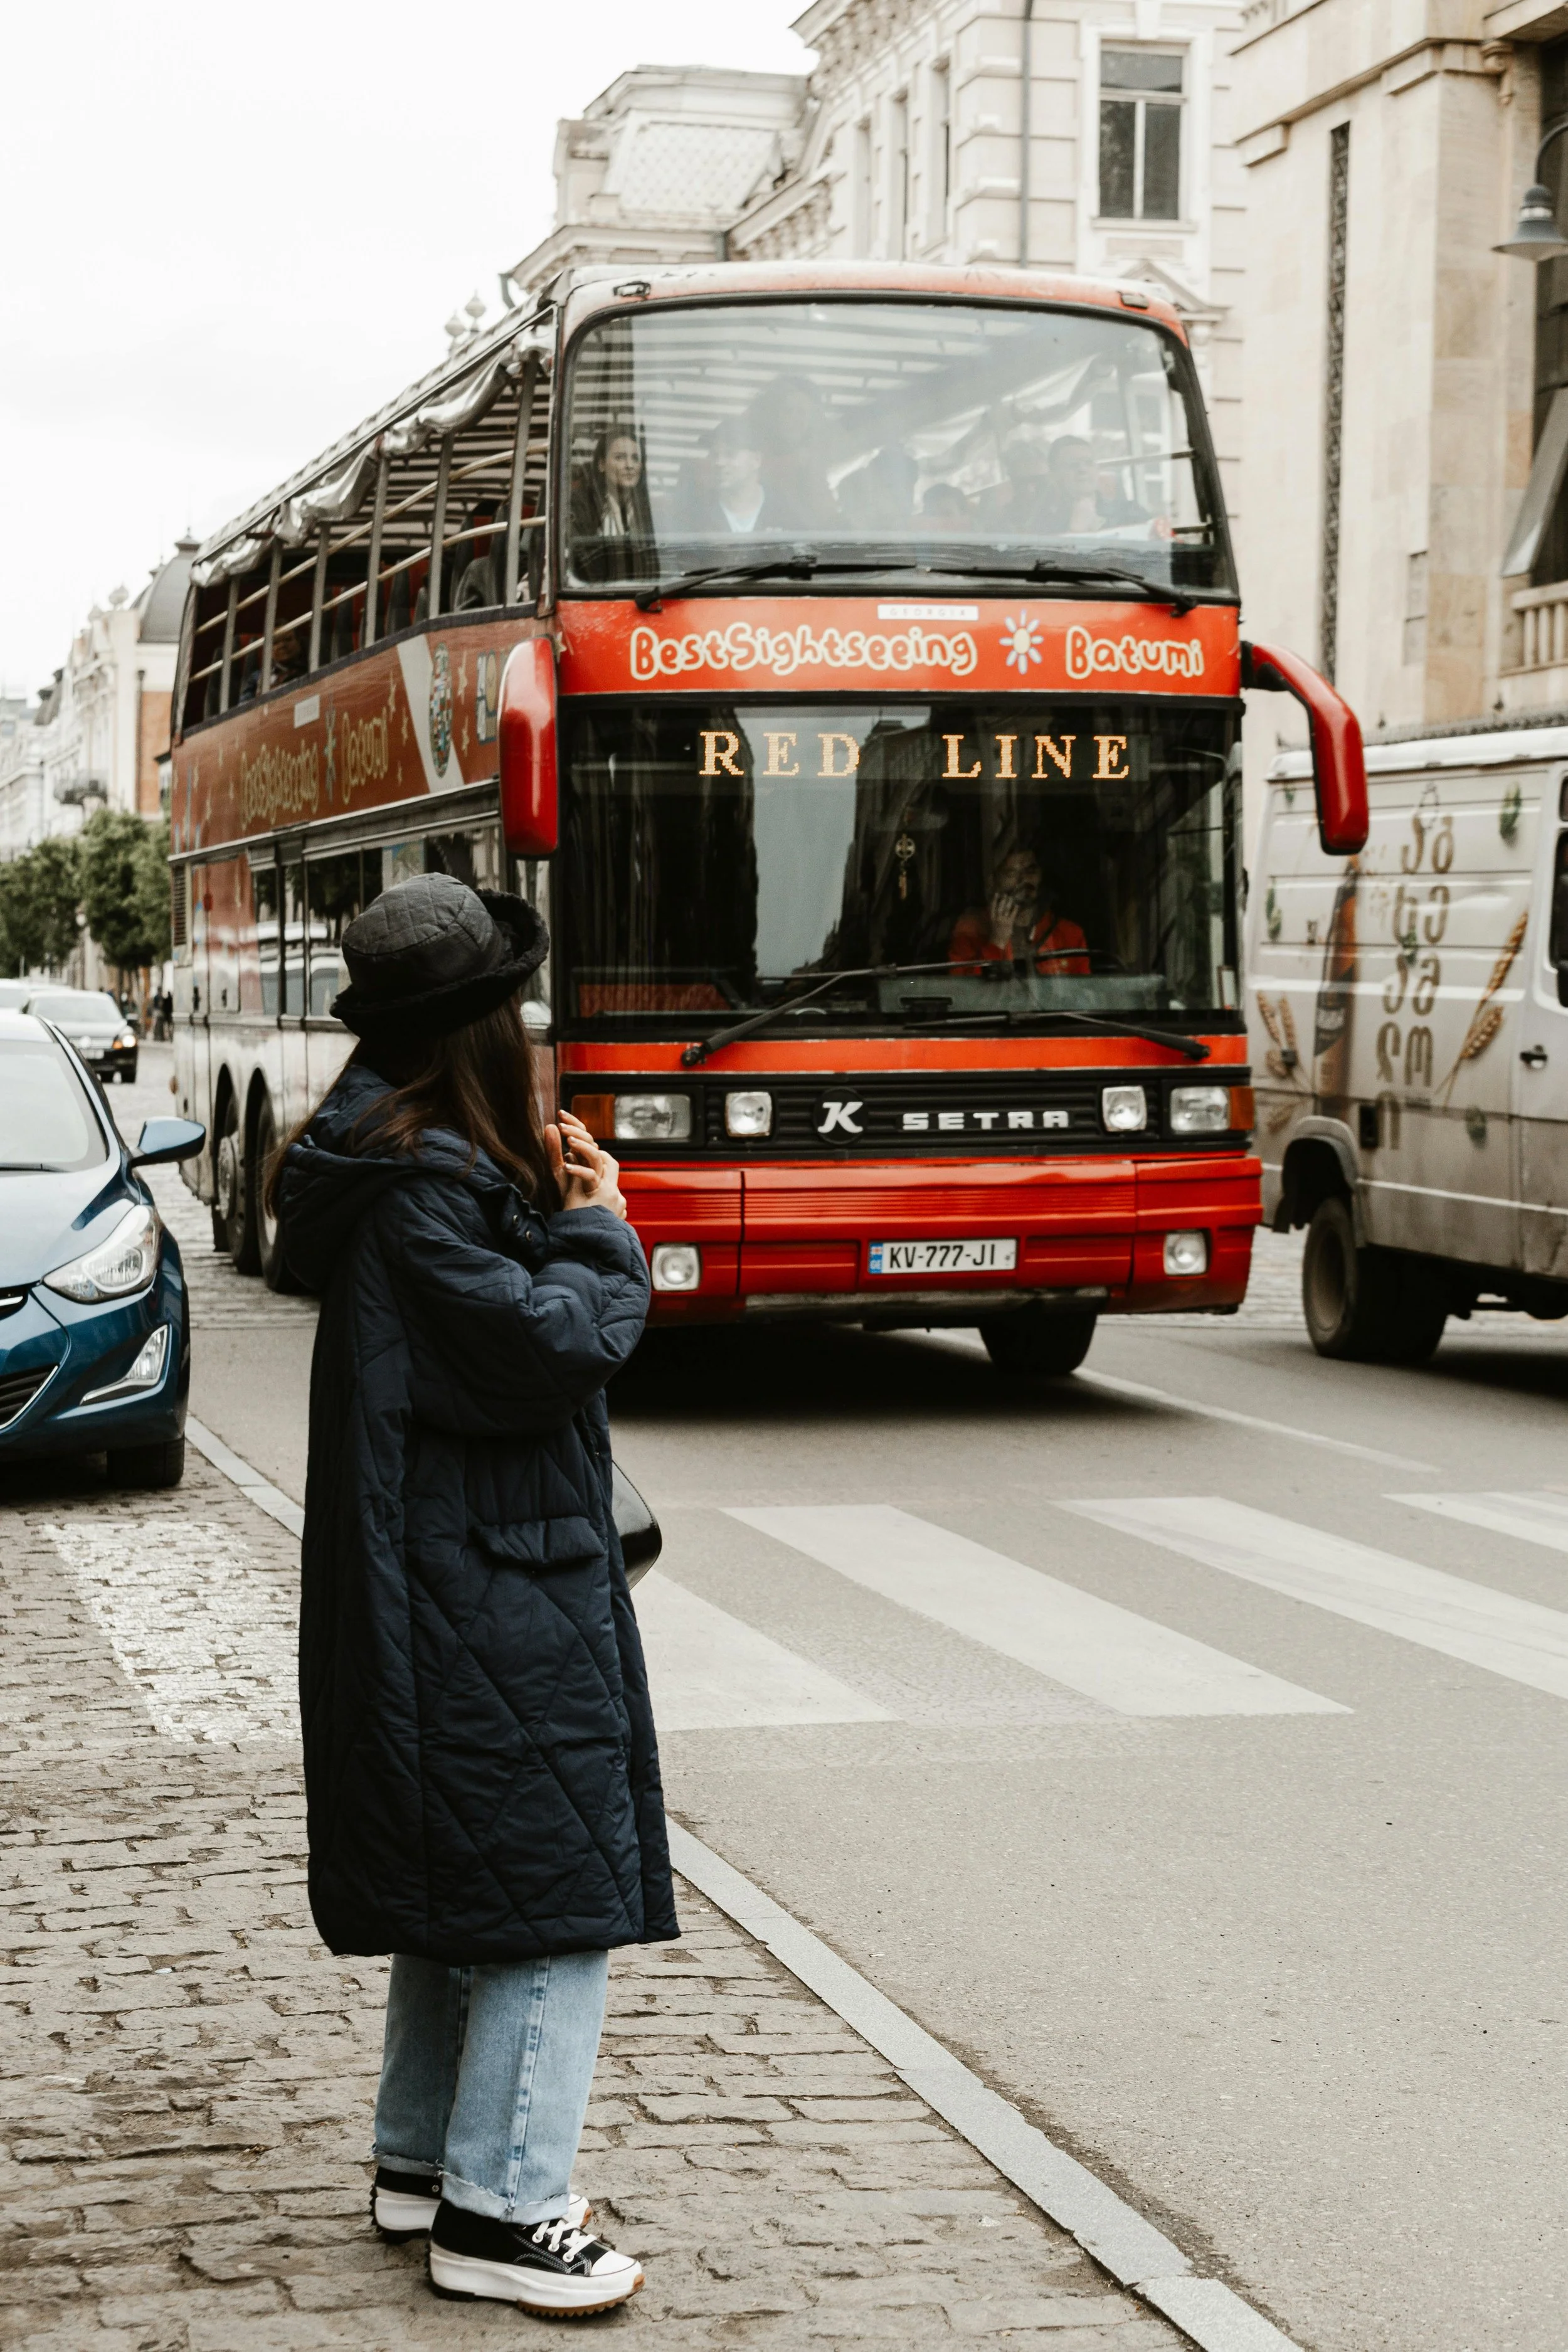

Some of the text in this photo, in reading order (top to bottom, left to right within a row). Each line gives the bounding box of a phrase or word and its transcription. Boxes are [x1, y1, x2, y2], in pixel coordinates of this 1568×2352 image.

[630, 622, 1204, 681] BestSightseeing Batumi
[699, 731, 1130, 779] RED LINE
[902, 1111, 1069, 1130] SETRA
[890, 1243, 995, 1269] KV-777-JI
